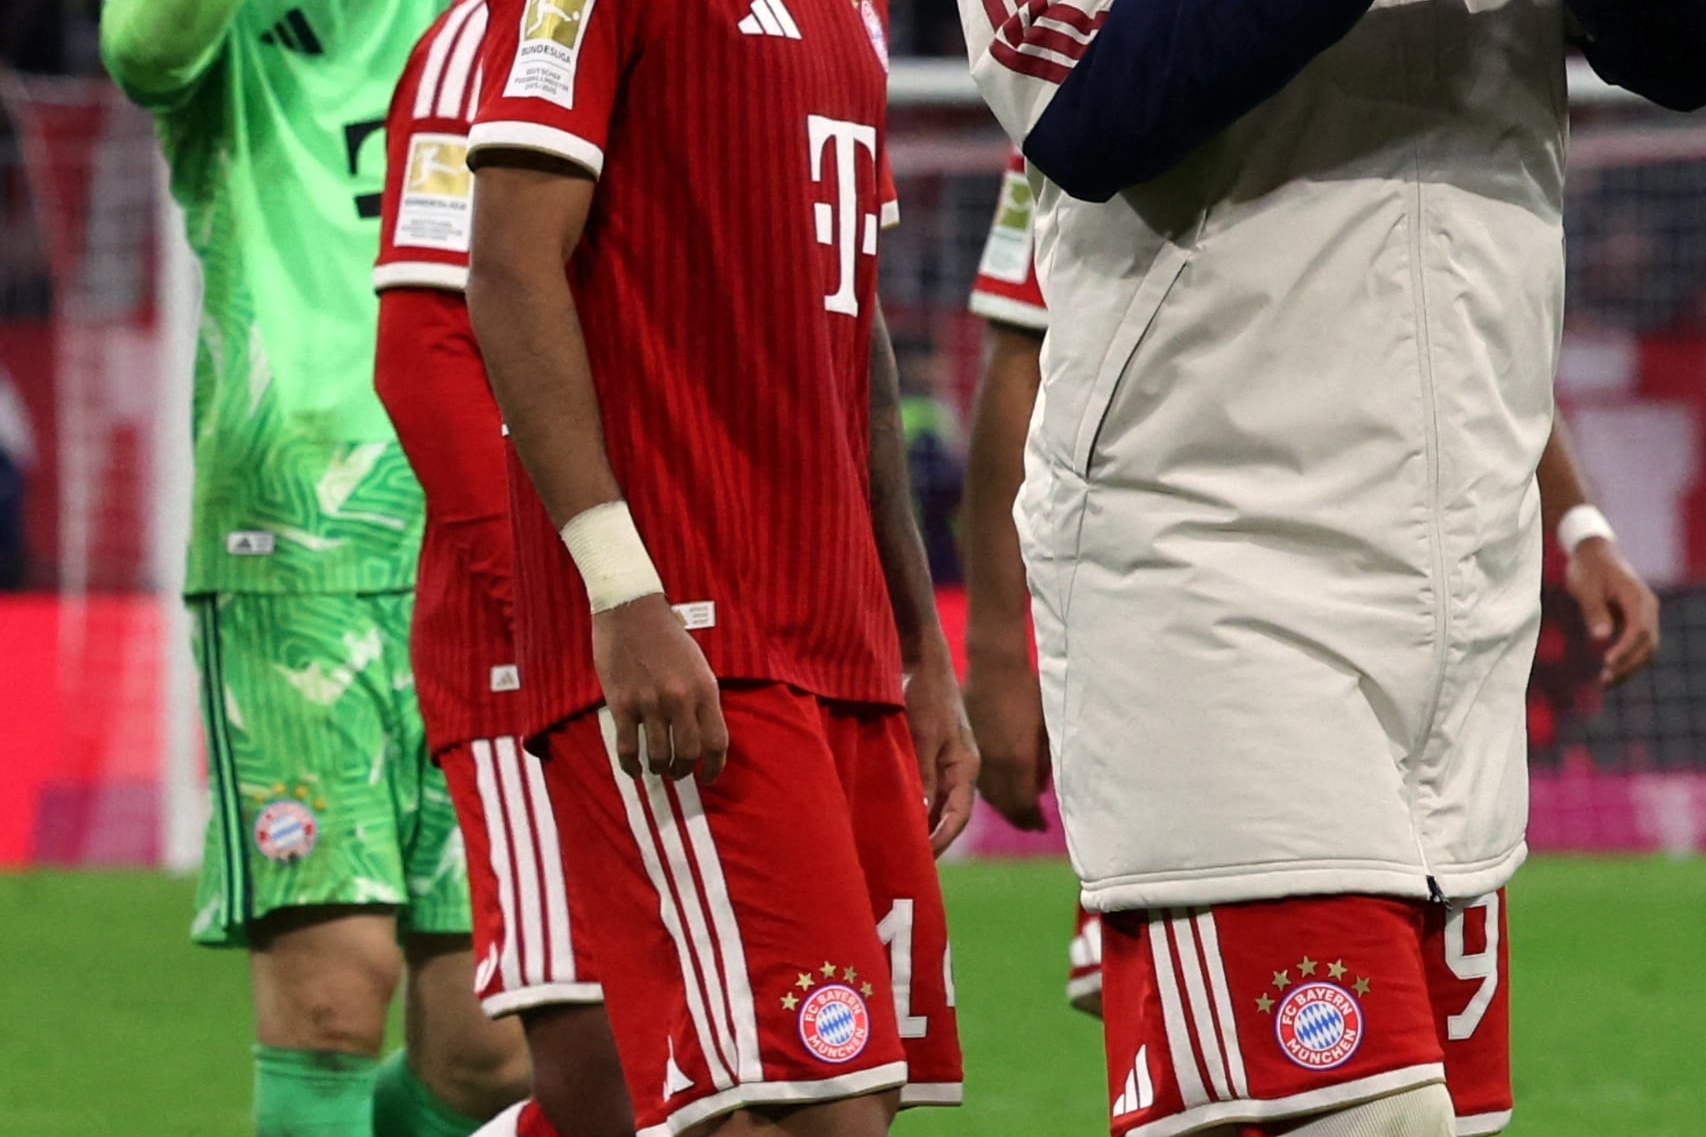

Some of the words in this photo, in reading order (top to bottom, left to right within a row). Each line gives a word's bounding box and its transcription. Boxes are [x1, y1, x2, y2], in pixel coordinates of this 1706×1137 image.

[807, 114, 877, 319] T
[805, 1004, 820, 1023] FC
[819, 990, 864, 1015] BAYERN
[1282, 1004, 1297, 1025] FC
[1295, 988, 1353, 1016] BAYERN
[1444, 891, 1499, 1041] 9
